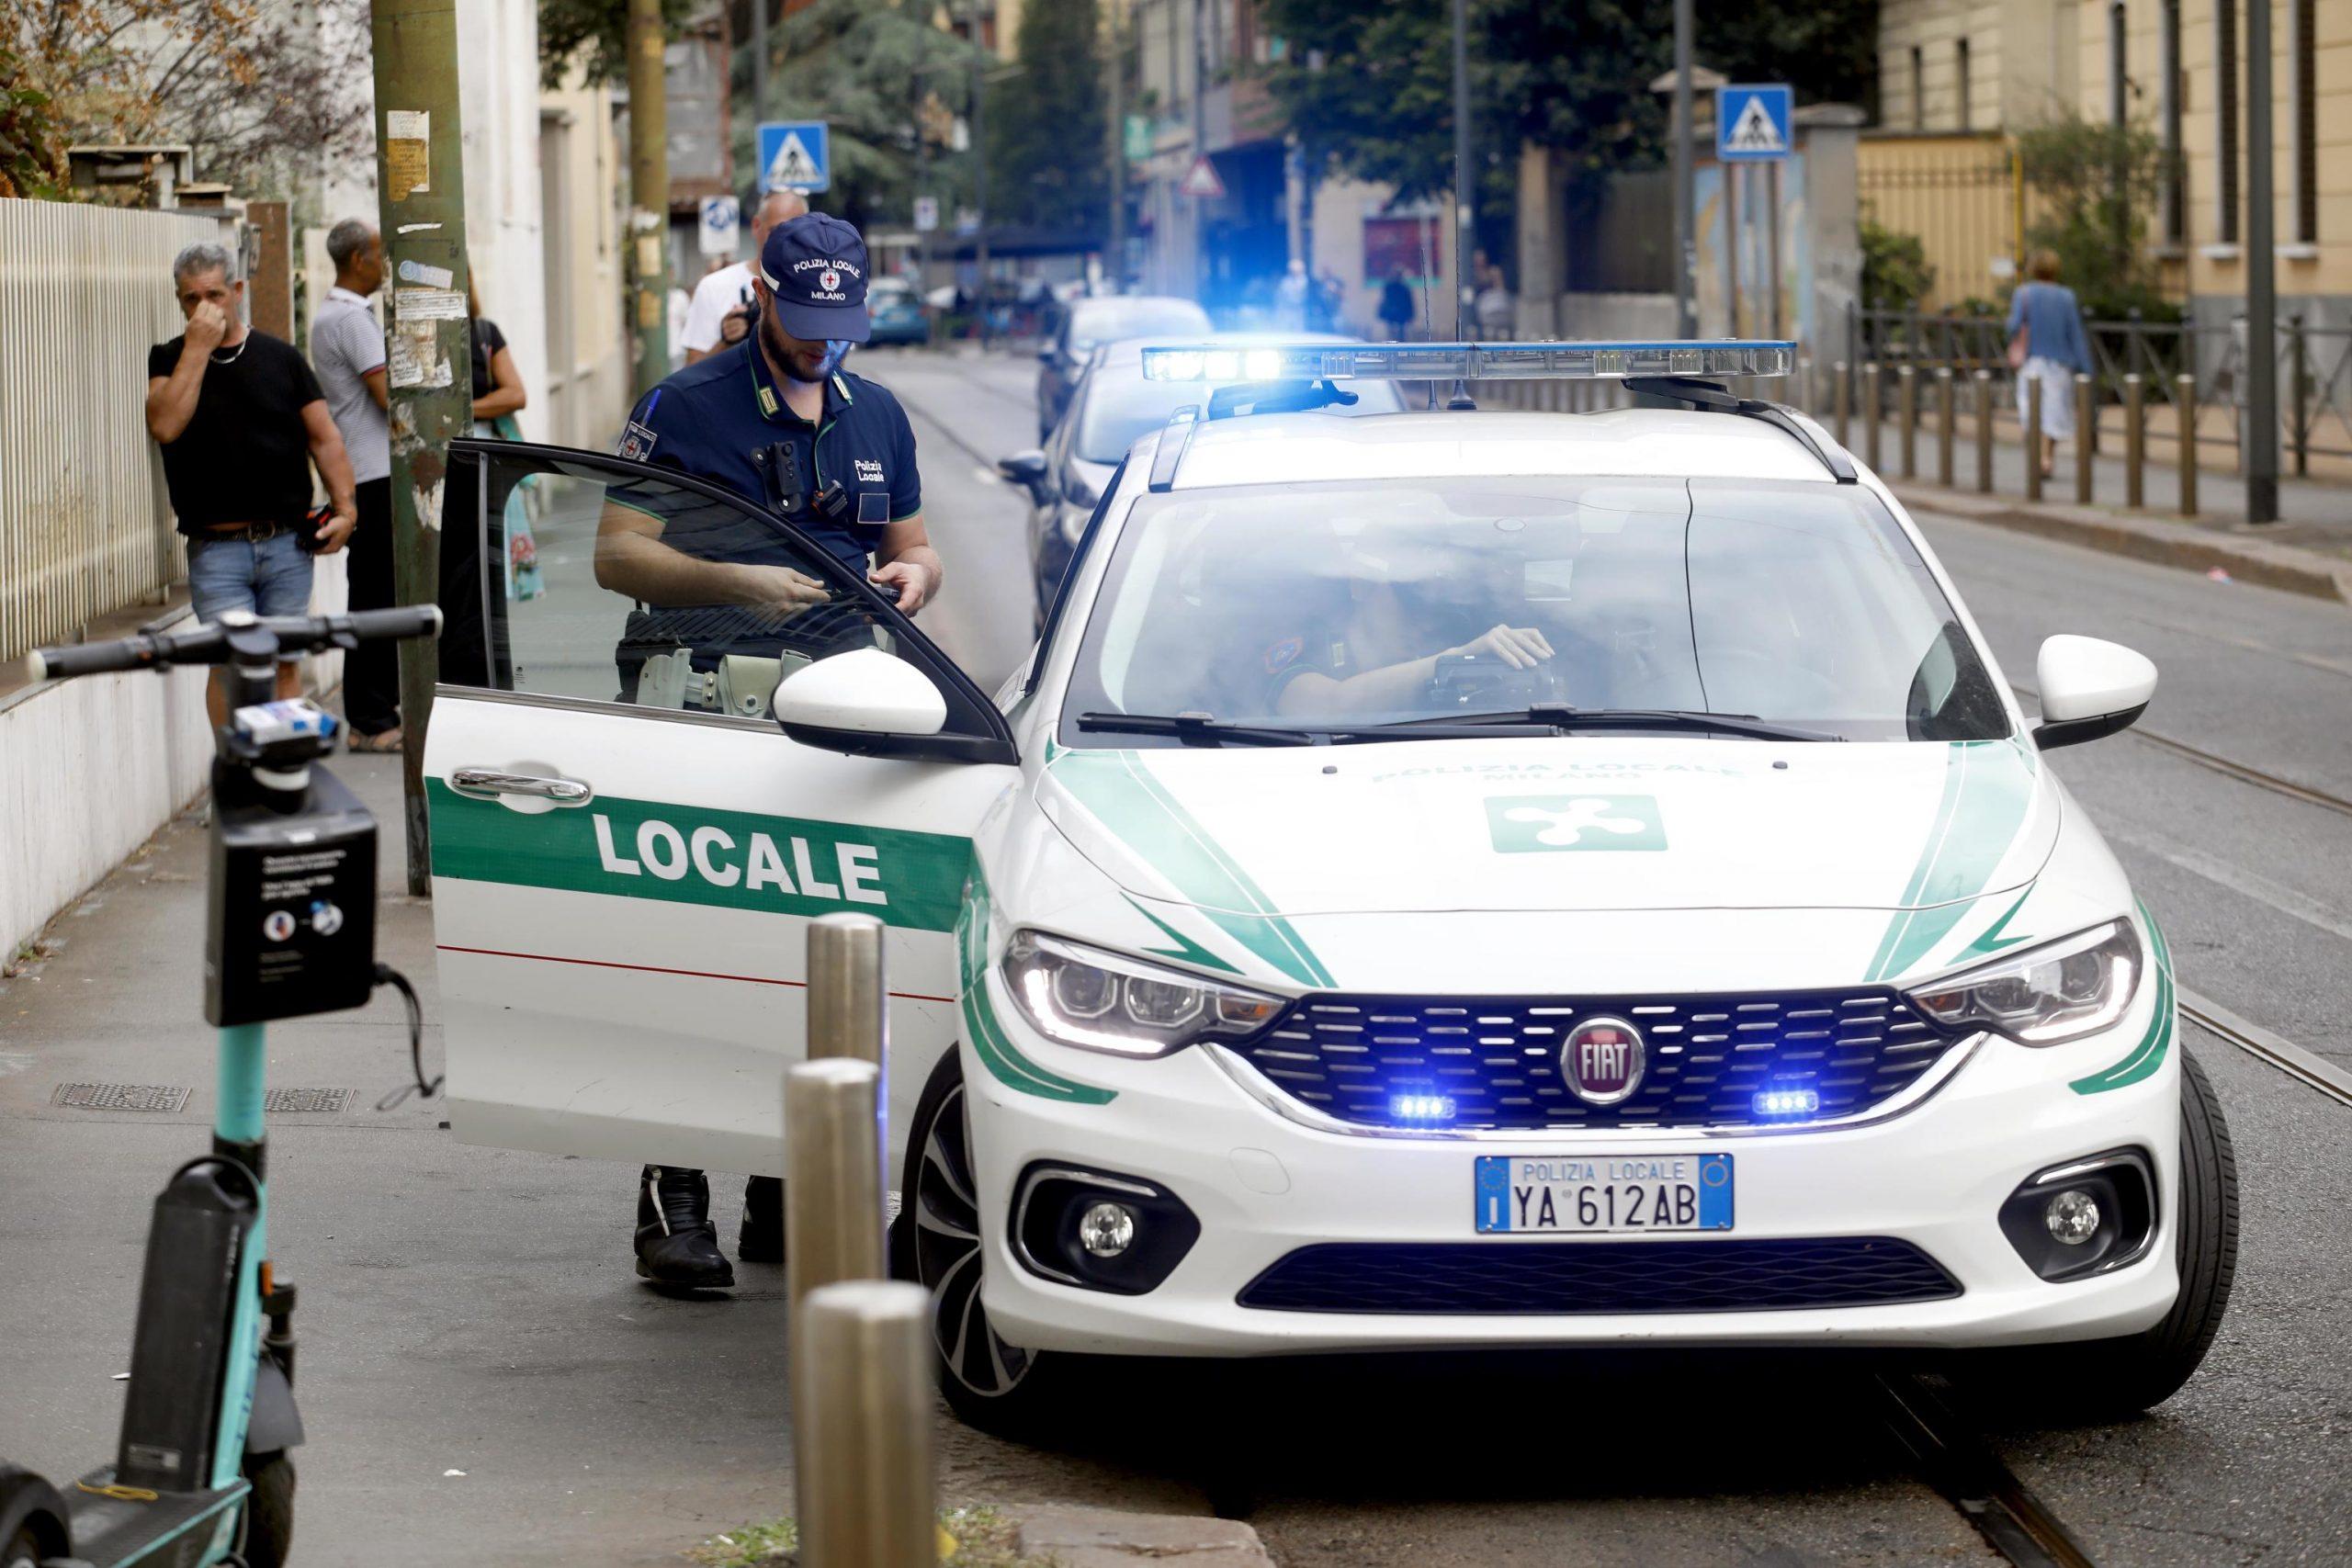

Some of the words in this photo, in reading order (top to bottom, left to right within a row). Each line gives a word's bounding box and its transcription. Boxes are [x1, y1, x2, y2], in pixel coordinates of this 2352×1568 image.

[793, 258, 830, 274] POLIZIA
[832, 259, 861, 278] LOCALE
[811, 290, 846, 301] MILANO
[854, 459, 882, 471] Polizia
[857, 471, 885, 482] Locale
[1372, 763, 1551, 783] POLIZIA
[1568, 763, 1747, 778] LOCALE
[1482, 773, 1642, 781] MILANO
[592, 813, 888, 906] LOCALE
[1581, 1043, 1628, 1080] FIAT
[1522, 1162, 1596, 1182] POLIZIA
[1610, 1161, 1685, 1181] LOCALE
